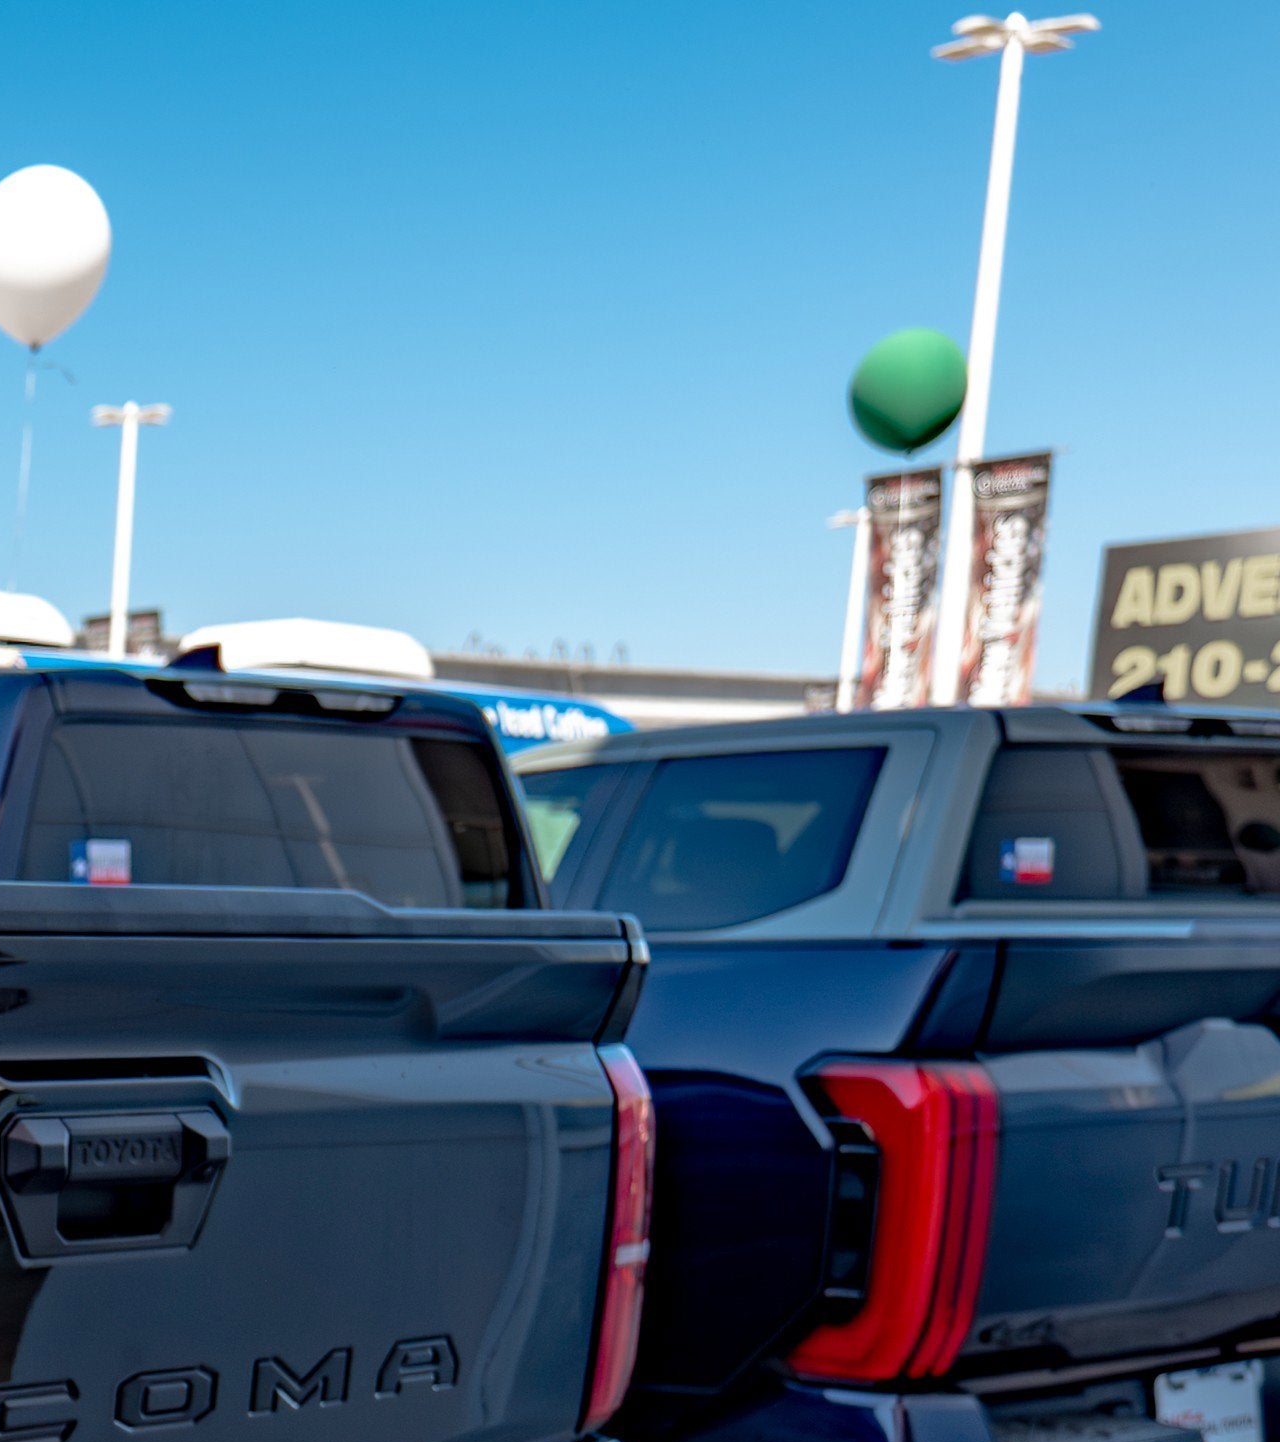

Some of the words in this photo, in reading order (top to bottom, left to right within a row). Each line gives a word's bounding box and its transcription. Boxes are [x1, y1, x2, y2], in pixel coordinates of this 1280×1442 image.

[1109, 553, 1280, 629] ADVE
[78, 1136, 181, 1166] TOYOTA
[1155, 1158, 1280, 1238] TU
